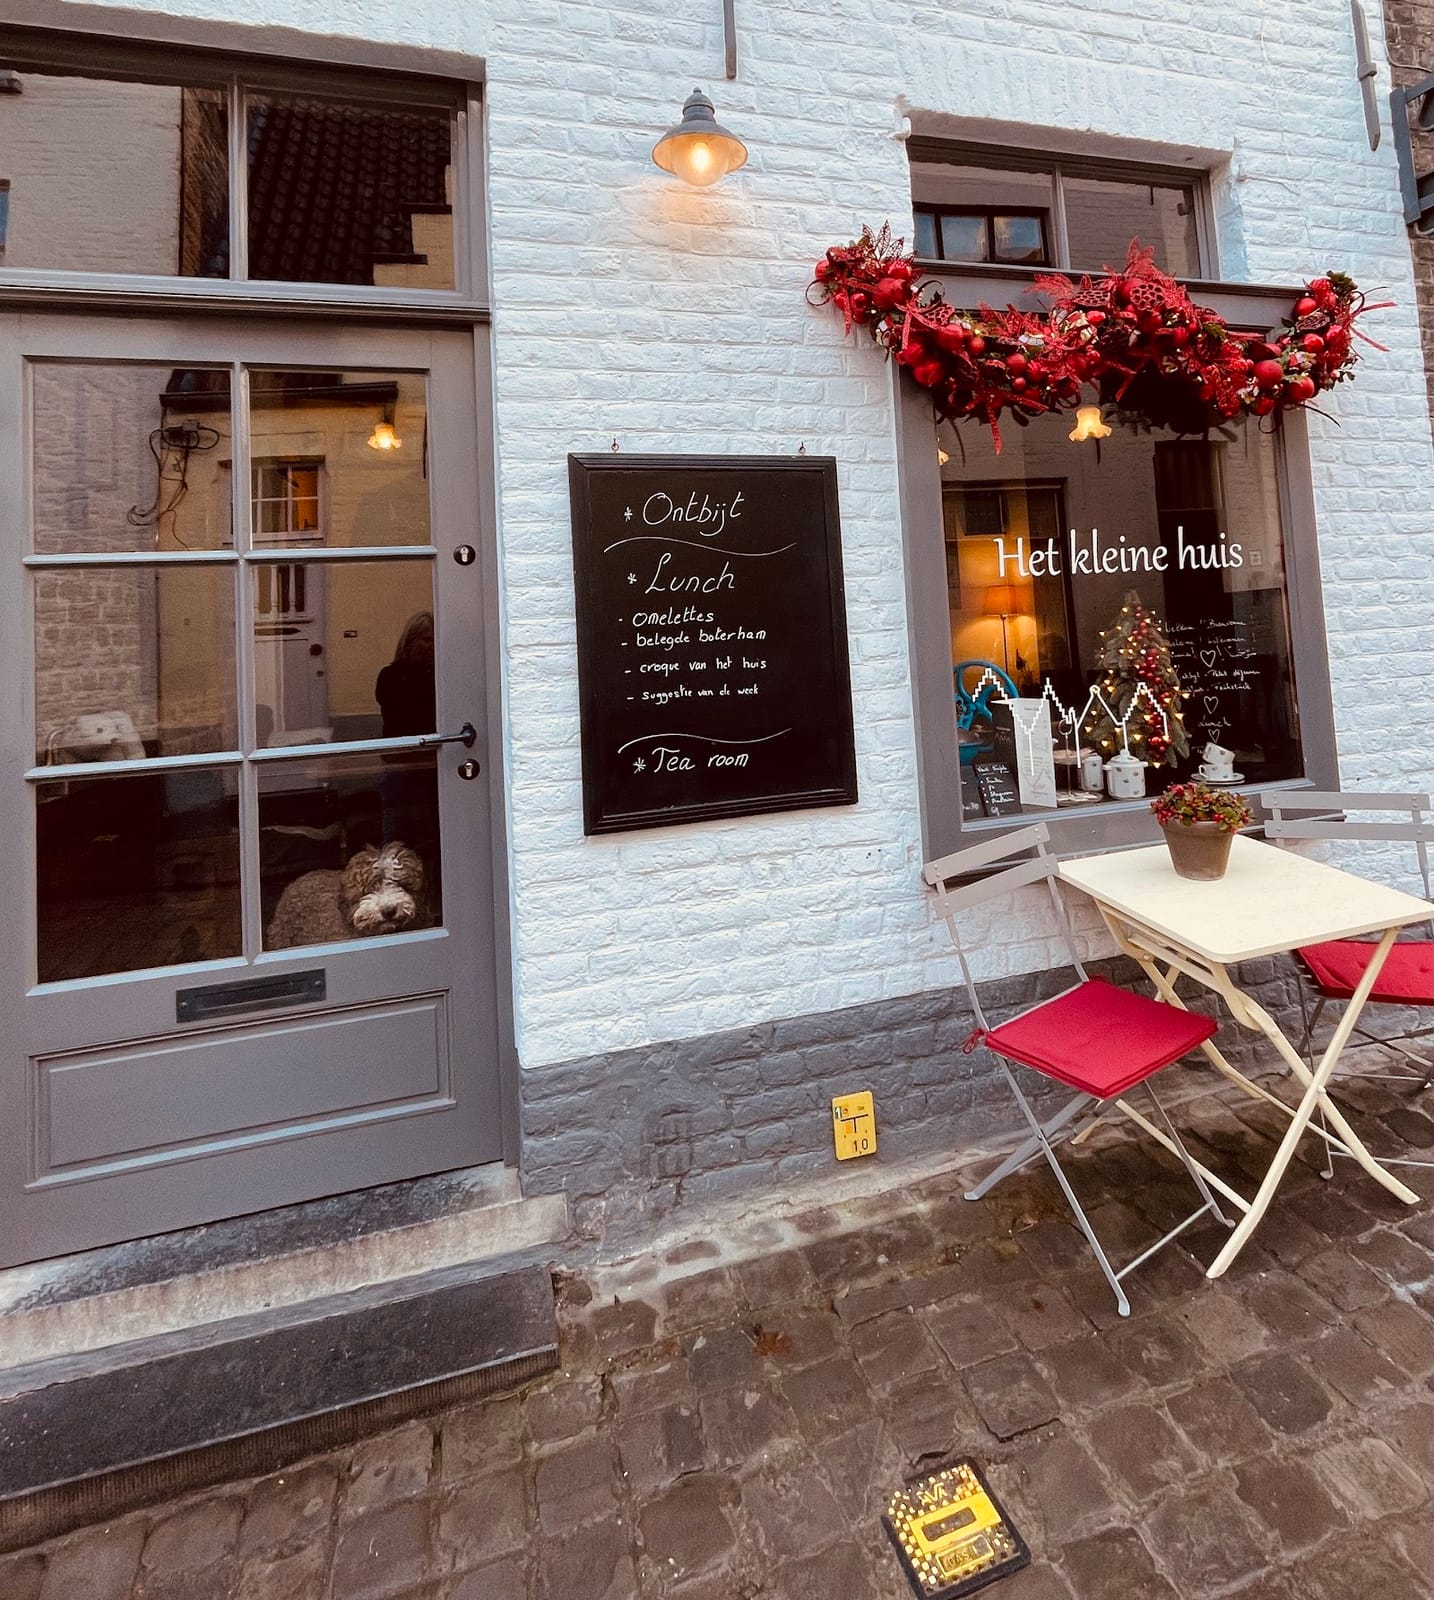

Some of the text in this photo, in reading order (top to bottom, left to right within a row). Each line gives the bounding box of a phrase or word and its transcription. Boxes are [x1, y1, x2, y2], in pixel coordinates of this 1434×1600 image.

[642, 491, 745, 536] Ontbijt
[993, 526, 1243, 577] Het kleine huis
[644, 552, 736, 594] Lunch
[636, 625, 767, 651] belegde boterham
[639, 655, 767, 678] croque van het huis
[697, 689, 714, 697] van
[719, 683, 731, 696] de
[737, 683, 759, 695] week
[651, 747, 749, 773] Tea room
